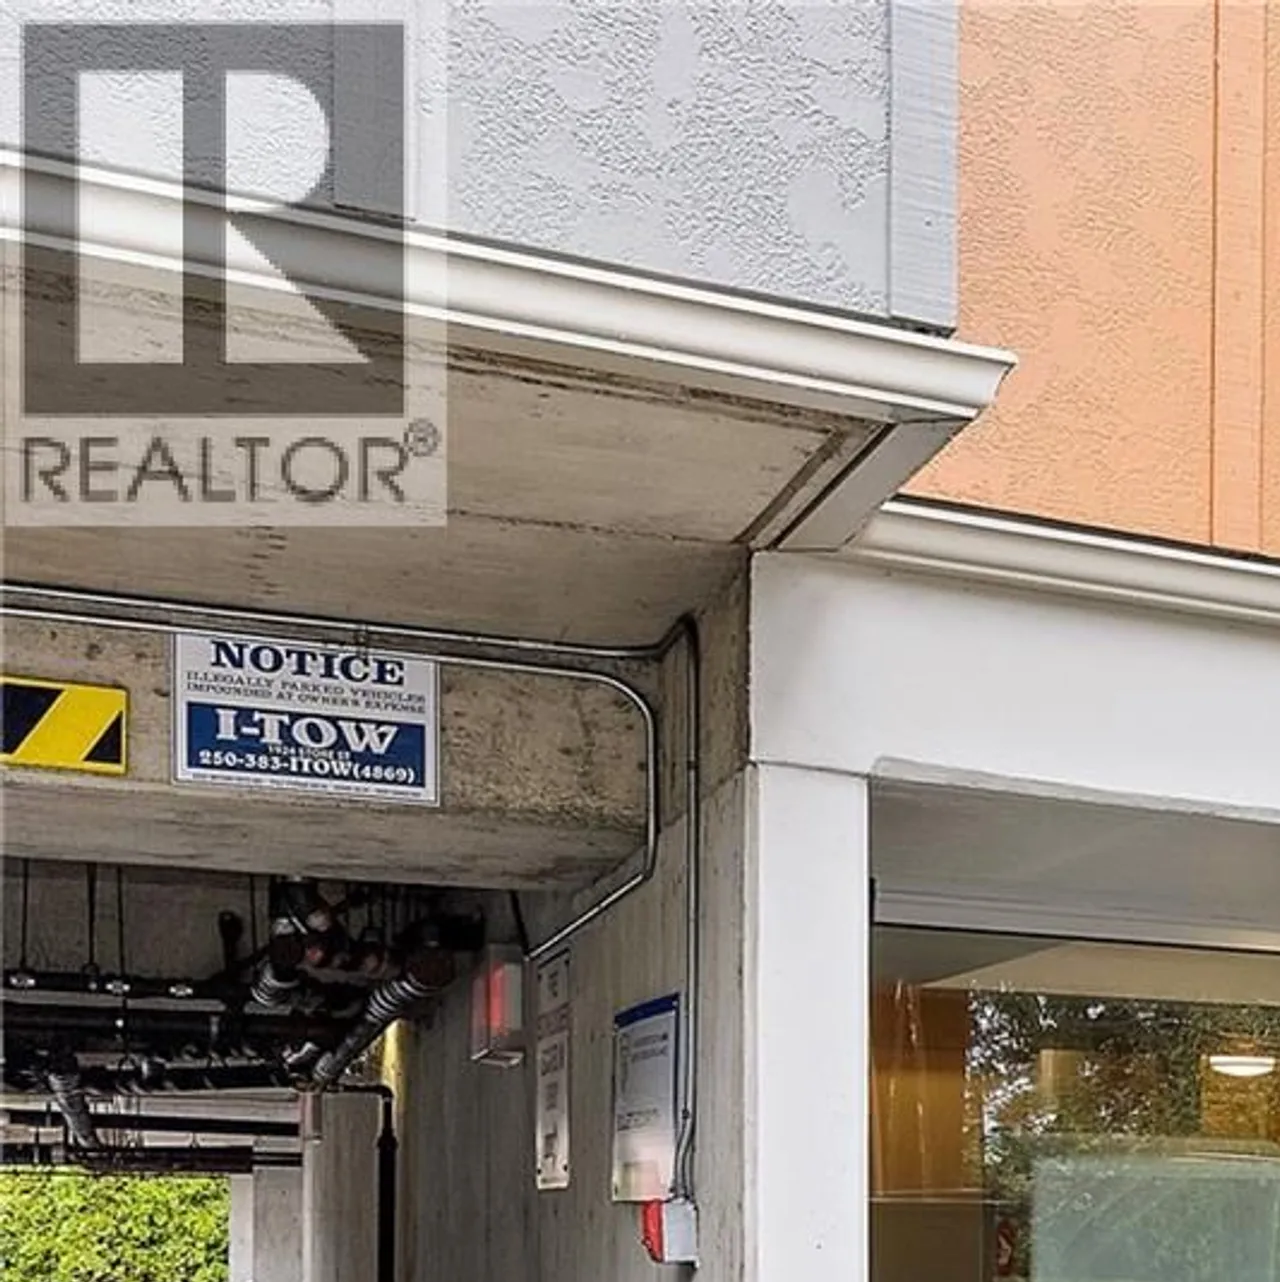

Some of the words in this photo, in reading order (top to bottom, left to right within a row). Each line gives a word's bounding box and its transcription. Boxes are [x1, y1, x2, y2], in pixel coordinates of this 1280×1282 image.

[211, 640, 405, 686] NOTICE
[187, 671, 275, 691] ILLEGALLY
[281, 682, 345, 696] PARKED
[351, 688, 427, 703] VEHICLES
[187, 683, 273, 700] IMPOUNDED
[276, 691, 296, 702] AT
[365, 699, 426, 714] EXPENSE
[215, 707, 398, 755] I-TOW
[199, 750, 415, 784] 250-383-ITOW(4869)
